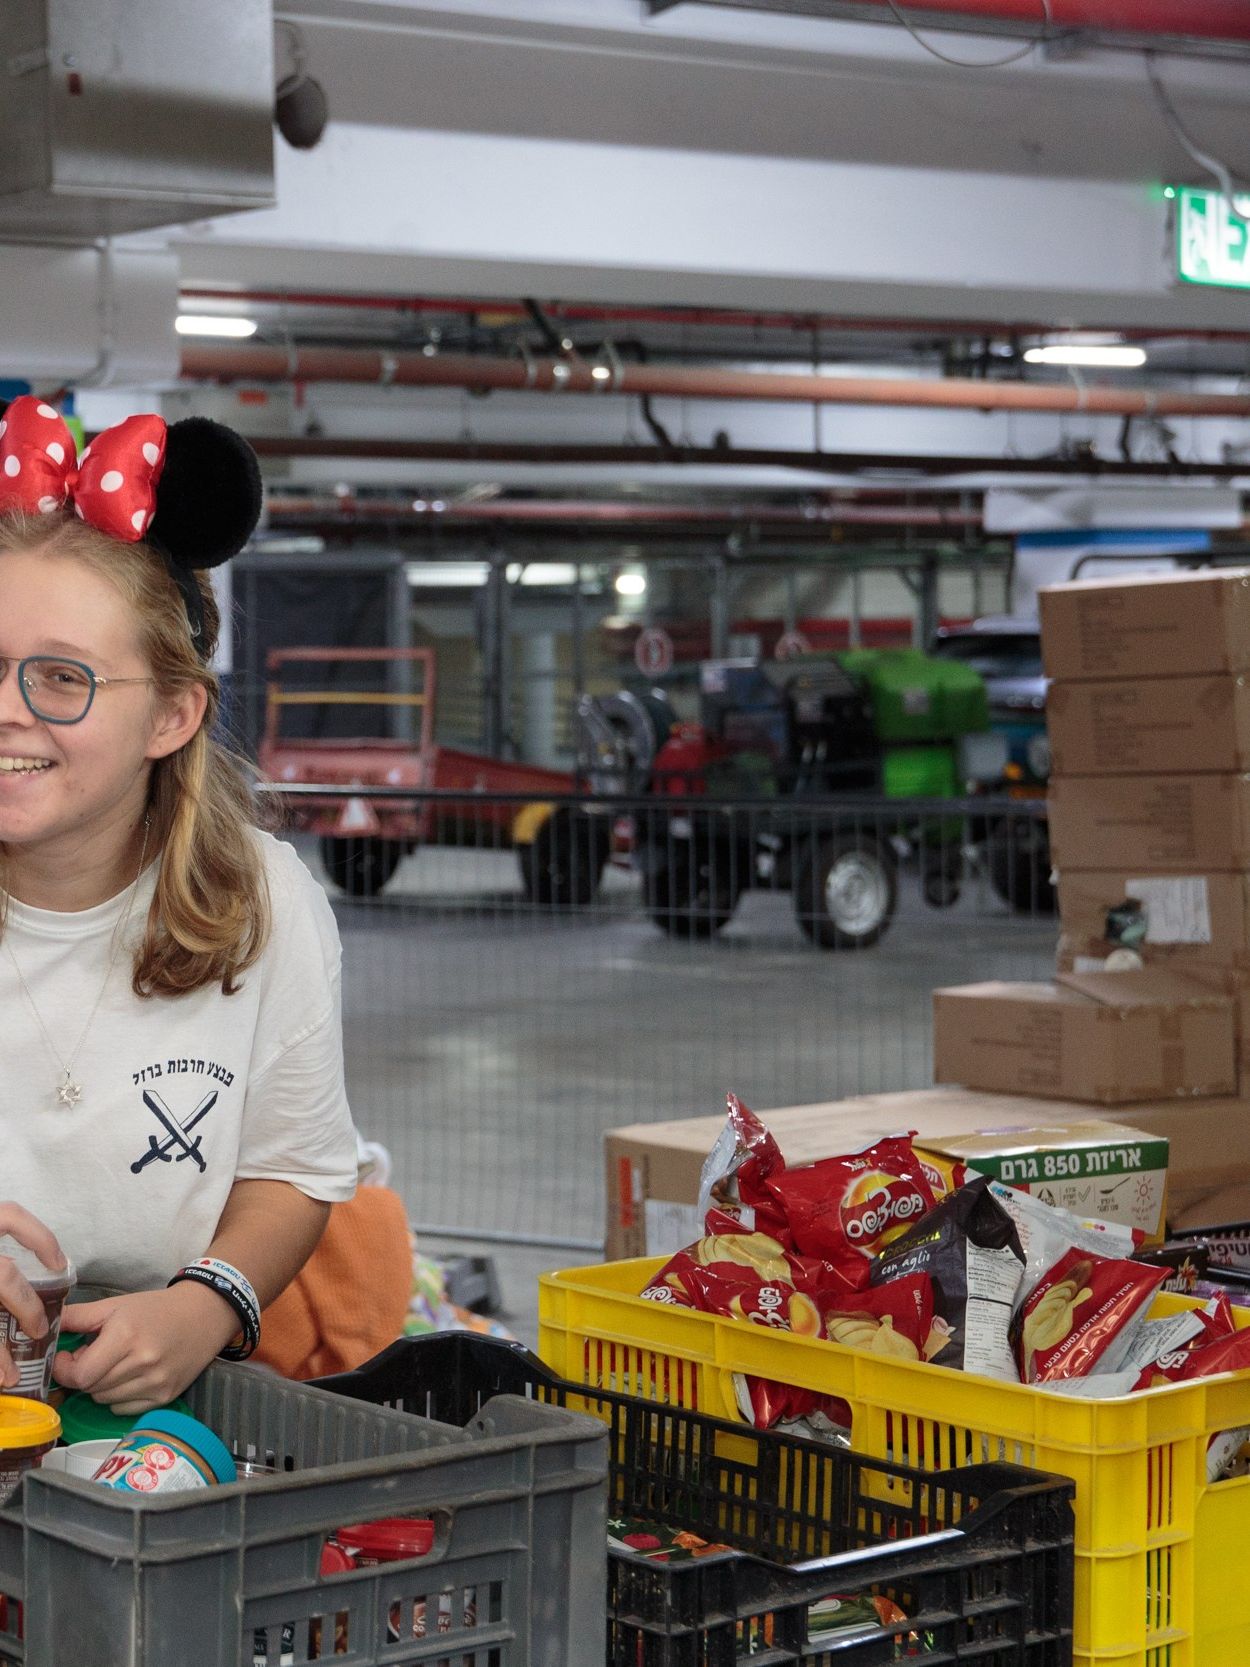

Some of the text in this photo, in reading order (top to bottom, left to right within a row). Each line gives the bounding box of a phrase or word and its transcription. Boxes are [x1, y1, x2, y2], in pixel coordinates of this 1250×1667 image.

[132, 1063, 162, 1085] ברזל
[167, 1058, 205, 1074] חרבות
[1000, 1148, 1142, 1181] אריזת 850 גרם
[881, 1250, 931, 1275] con aglio
[185, 1268, 214, 1281] ובנשמה
[1098, 1297, 1117, 1315] תפוח
[1079, 1313, 1100, 1334] אדמה
[1059, 1332, 1081, 1353] בטעם
[1043, 1352, 1062, 1369] טבעי
